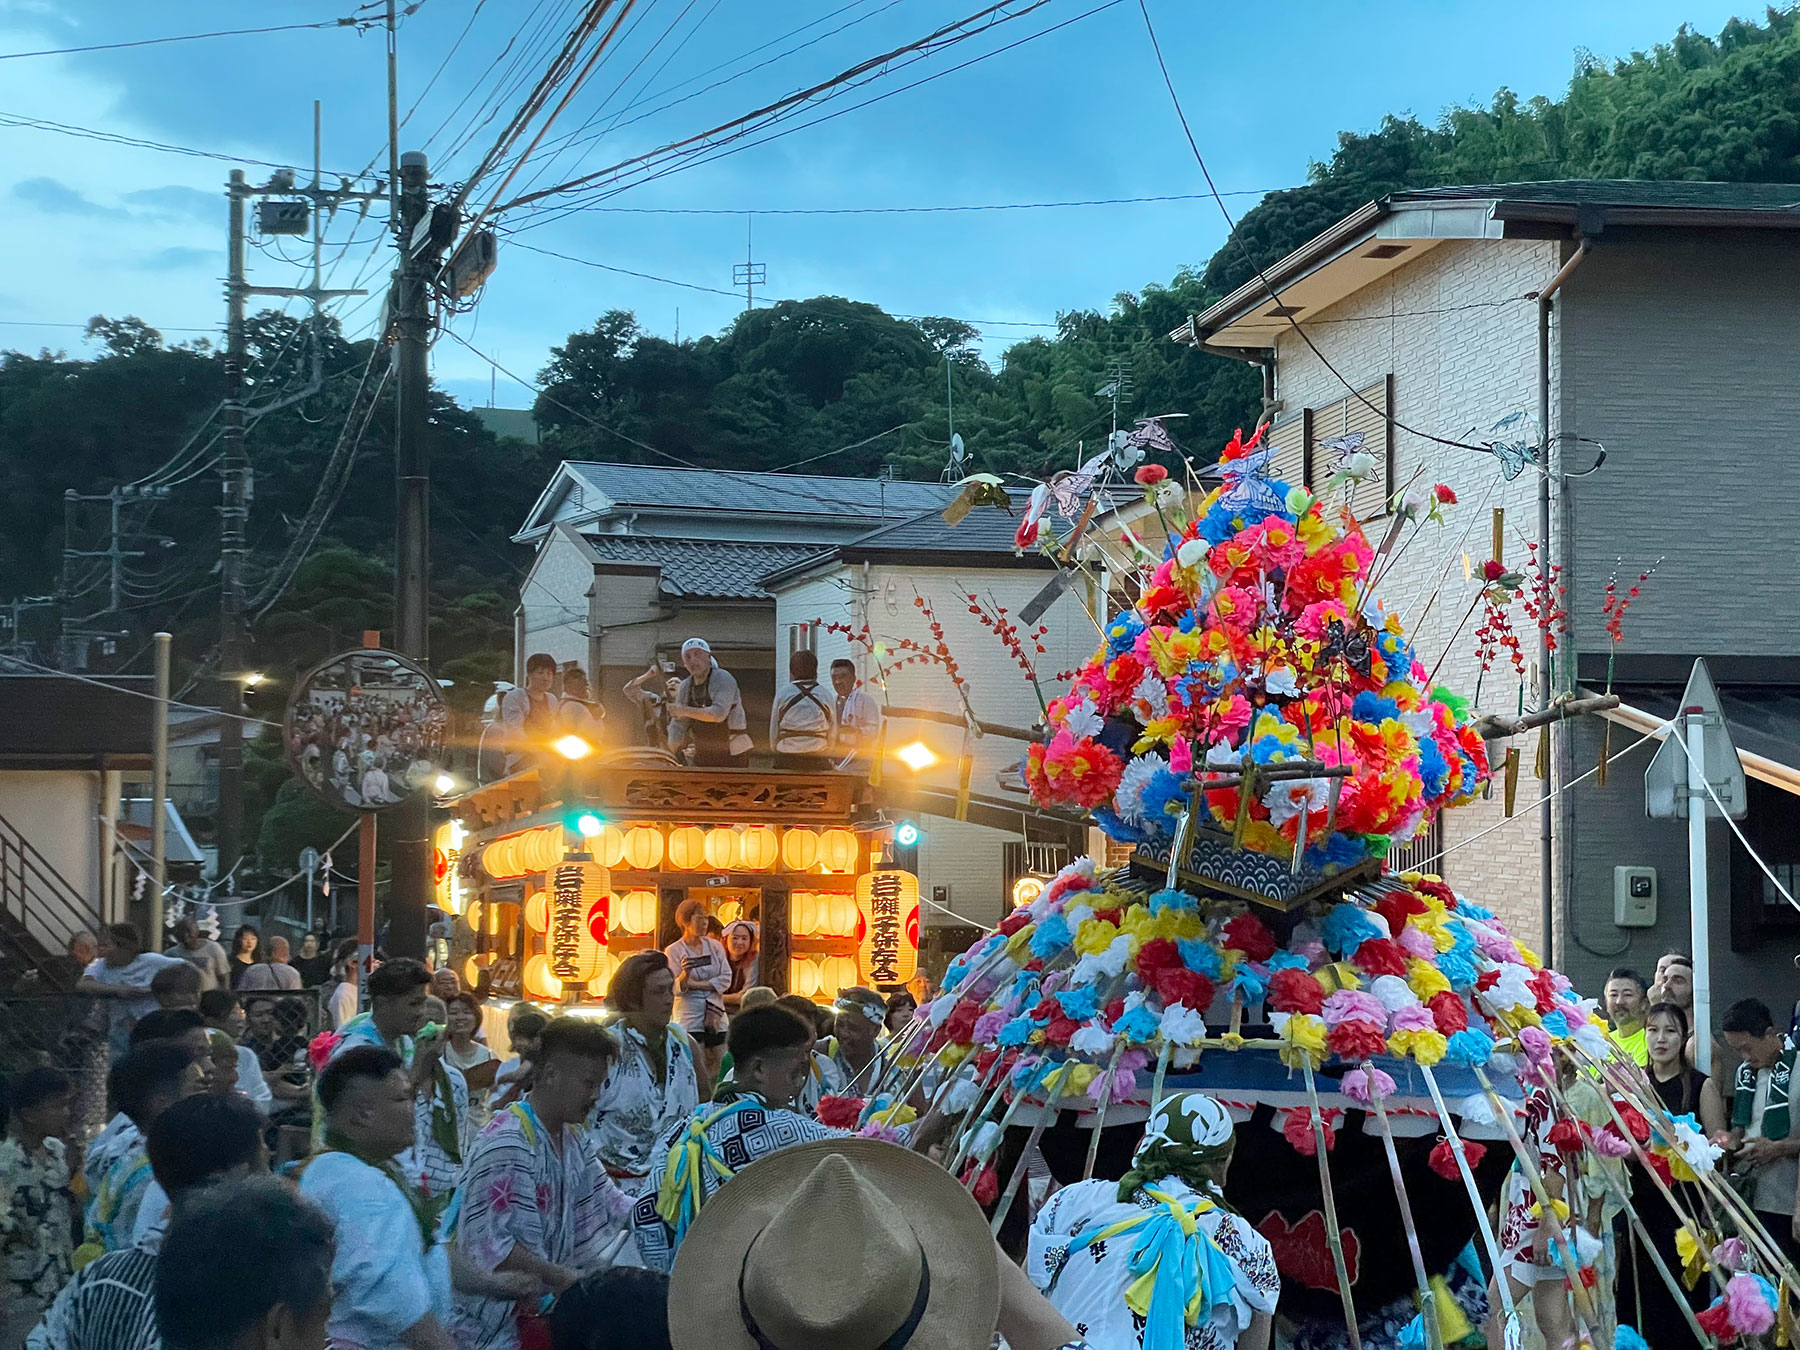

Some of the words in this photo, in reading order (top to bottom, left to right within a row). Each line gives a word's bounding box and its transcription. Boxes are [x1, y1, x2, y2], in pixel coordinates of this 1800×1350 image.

[870, 875, 902, 981] 岩囃子保存会
